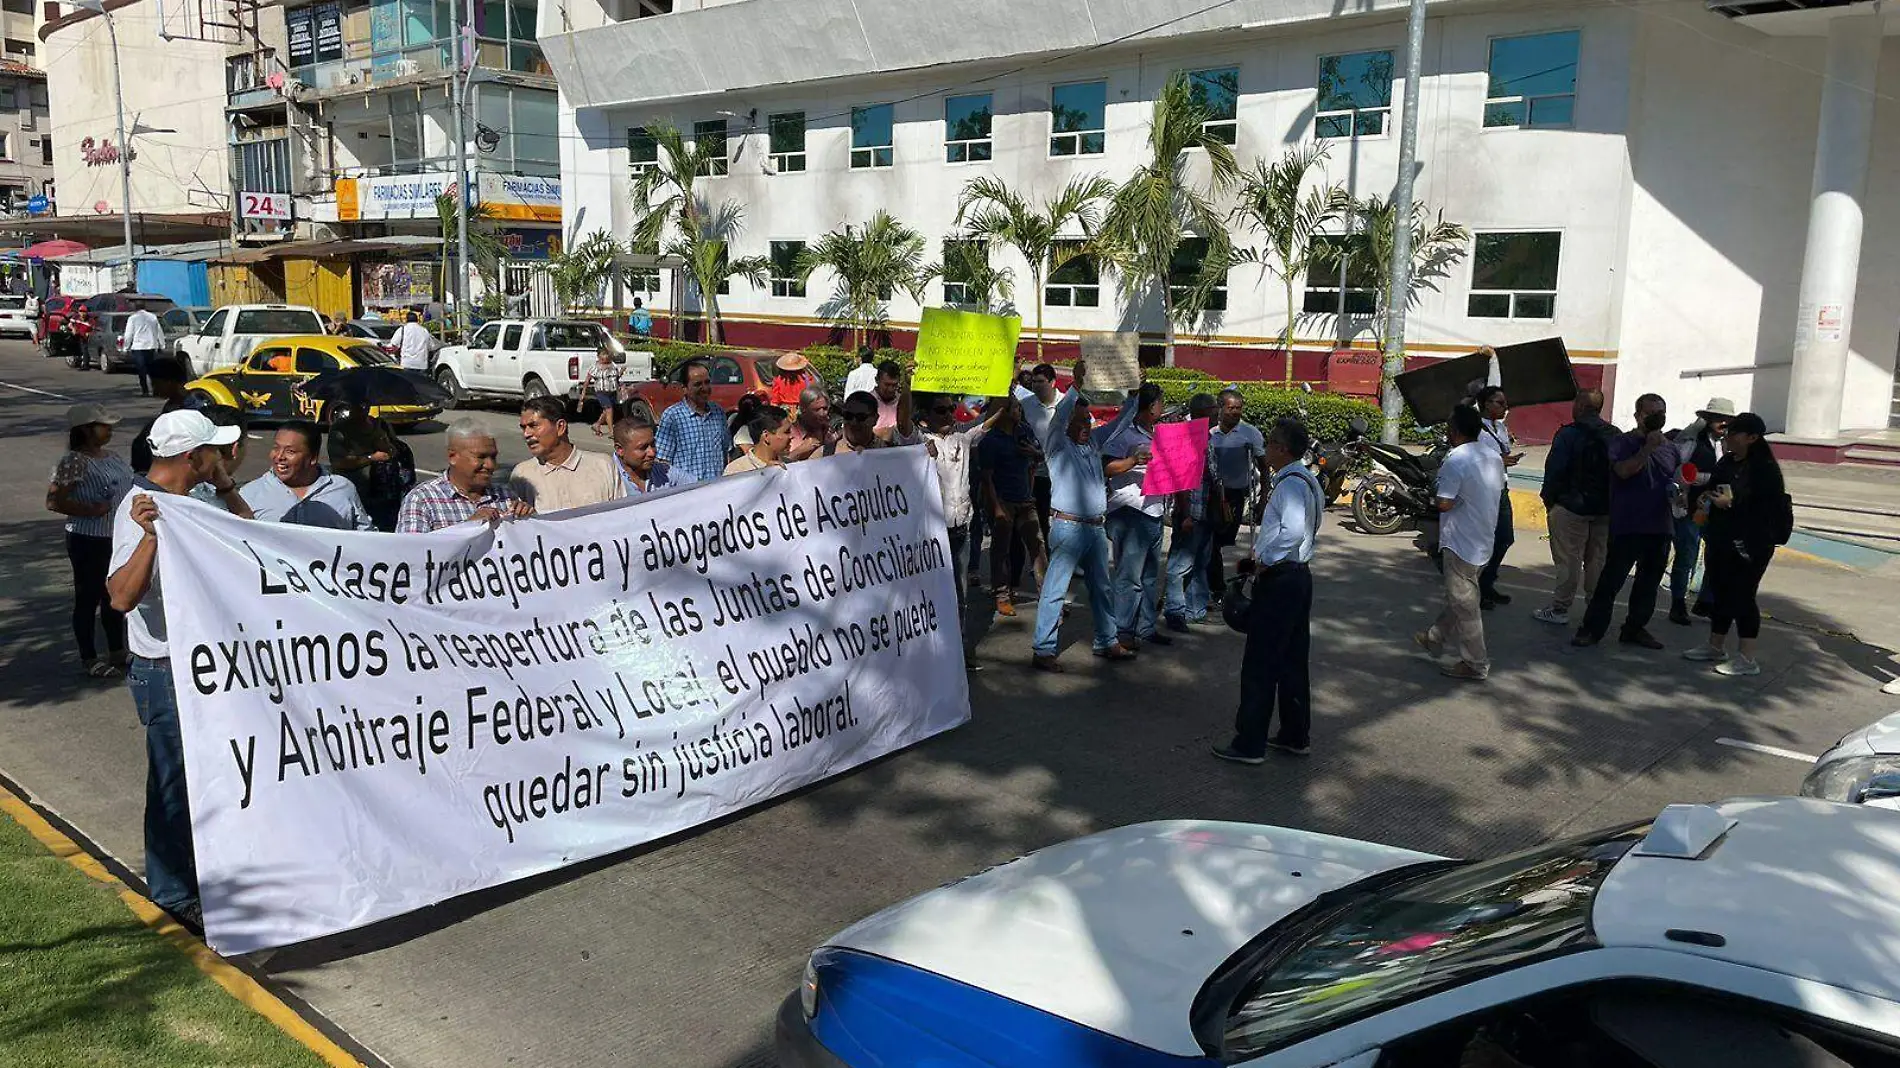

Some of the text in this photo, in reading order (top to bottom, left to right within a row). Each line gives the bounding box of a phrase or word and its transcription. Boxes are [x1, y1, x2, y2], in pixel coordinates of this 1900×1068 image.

[246, 196, 273, 214] 24
[373, 183, 407, 200] FARMACIAS
[243, 474, 909, 610] La clase trabajadora y abogados de Acapulco
[190, 619, 389, 705] exigimos
[387, 618, 440, 673] la
[434, 616, 608, 681] reapertura
[610, 599, 652, 646] de
[648, 591, 705, 639] las
[706, 571, 800, 628] Juntas
[803, 554, 837, 603] de
[230, 735, 256, 809] y
[278, 696, 450, 782] Arbitraje
[466, 679, 604, 750] Federal
[595, 687, 626, 740] y
[715, 644, 751, 696] el
[748, 623, 833, 702] pueblo
[832, 621, 866, 661] no
[869, 614, 891, 652] se
[893, 589, 939, 657] puede
[484, 679, 858, 844] quedar sin justicia laboral.
